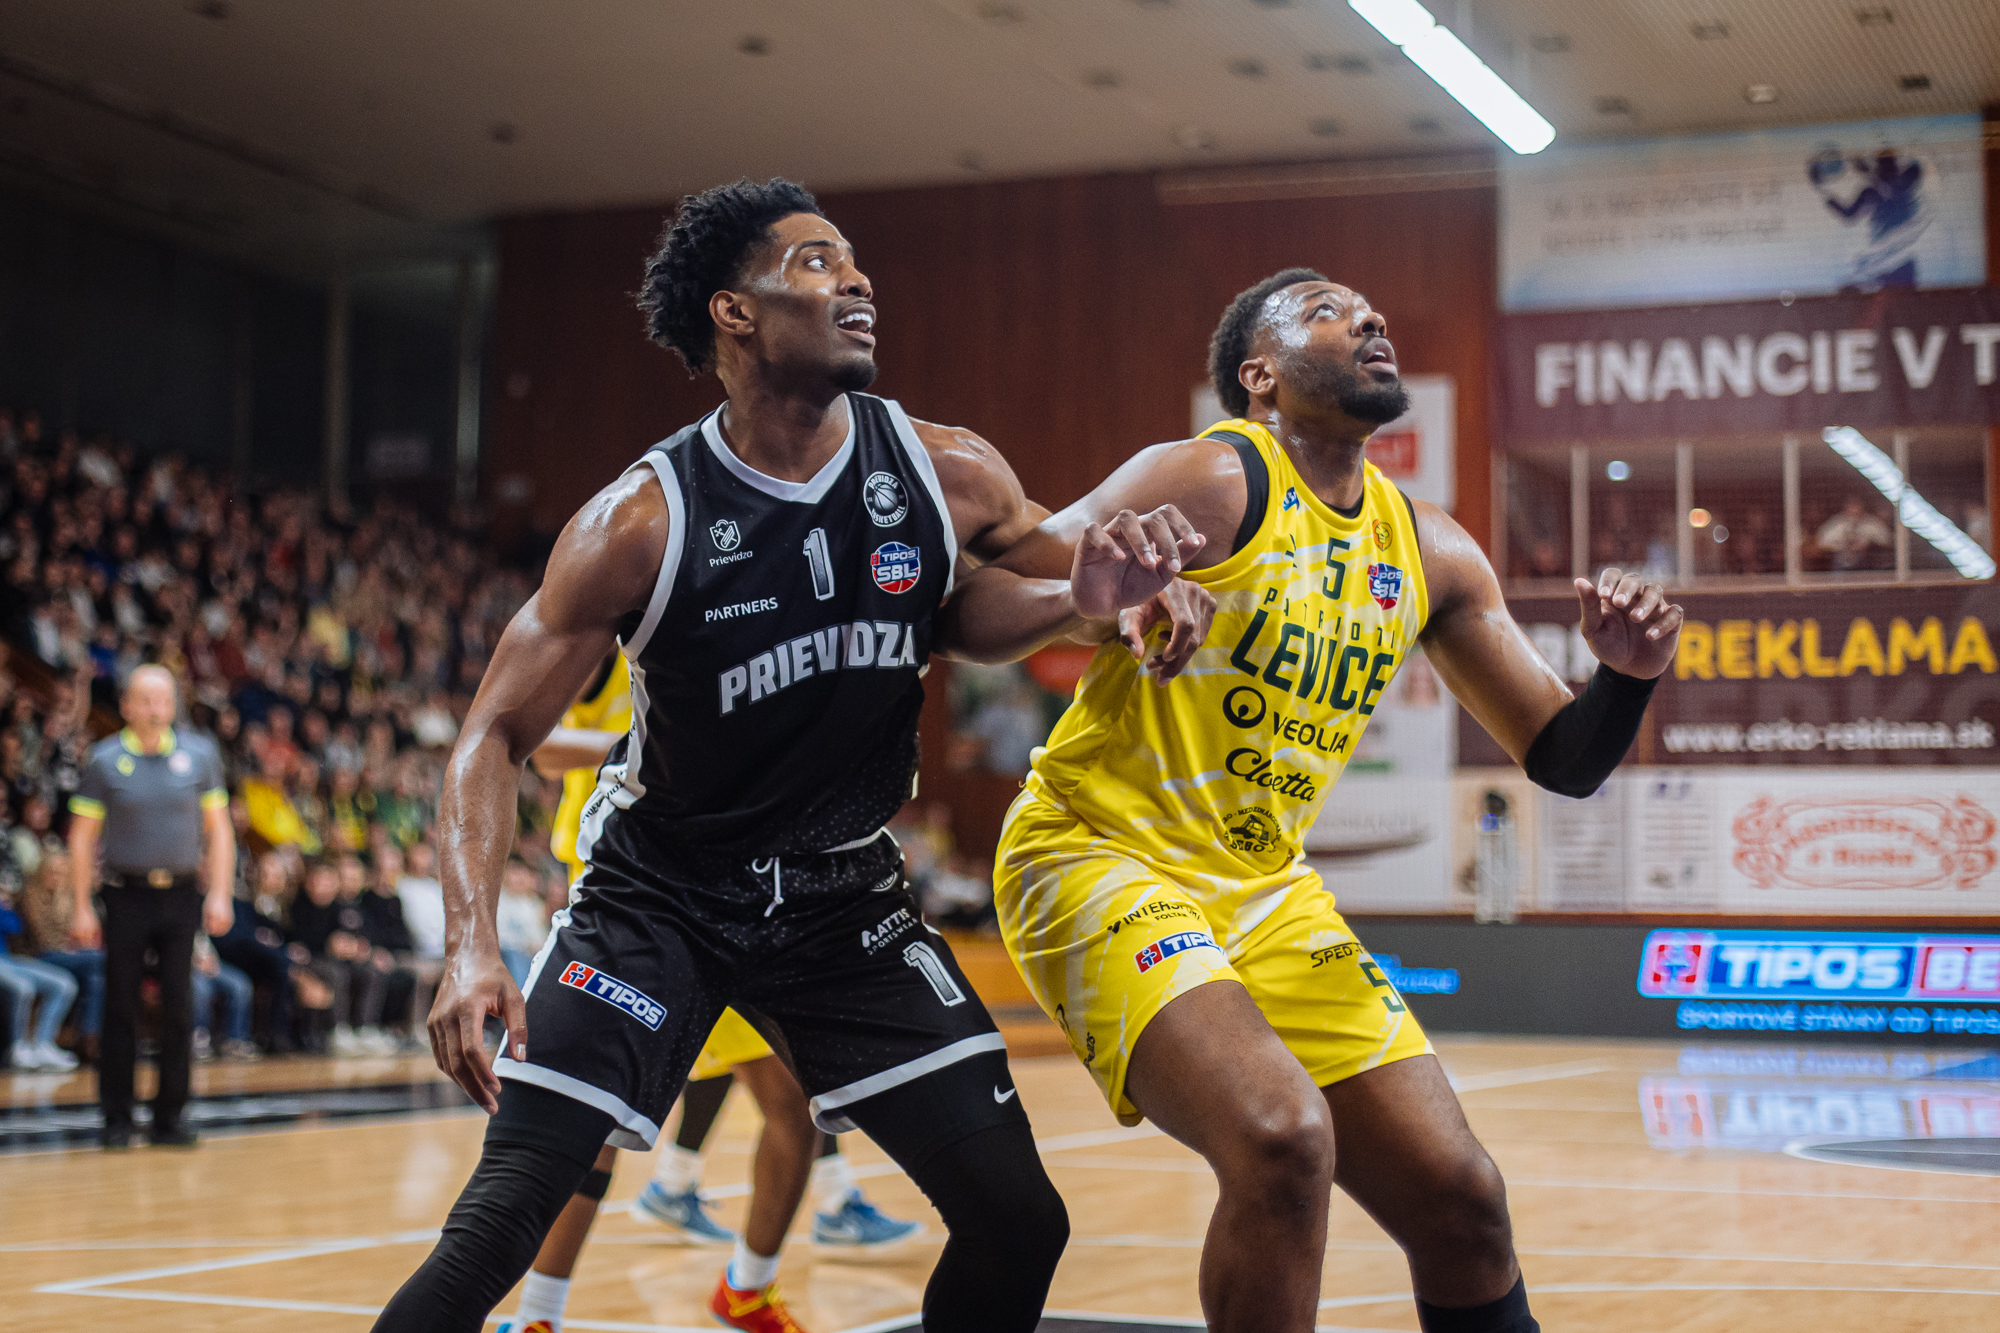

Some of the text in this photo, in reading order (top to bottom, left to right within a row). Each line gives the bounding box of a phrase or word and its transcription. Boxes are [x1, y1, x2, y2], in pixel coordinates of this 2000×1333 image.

[1535, 329, 1880, 408] FINANCIE
[1892, 326, 1948, 389] V
[868, 474, 899, 490] PREVIDZA
[871, 505, 906, 524] ASKETBALL
[709, 550, 753, 567] Prievidza
[803, 527, 835, 601] 1
[876, 563, 917, 582] SBL
[881, 549, 916, 562] TIPOS
[1322, 537, 1350, 600] 5
[1379, 570, 1403, 580] POS
[705, 597, 778, 622] PARTNERS
[718, 619, 918, 718] PRIEVIDZA
[1229, 608, 1394, 716] LEVICE
[1674, 616, 1998, 680] REKLAMA
[1273, 711, 1349, 753] VEOLIA
[1663, 717, 1995, 753] www.erko-reklama.sk
[1225, 748, 1315, 802] Cloetta
[877, 908, 911, 938] ATTIS
[1164, 934, 1221, 953] TIPO
[902, 941, 967, 1007] 1
[1359, 962, 1406, 1013] 5
[1720, 946, 1903, 989] TIPOS
[597, 976, 663, 1025] TIPOS
